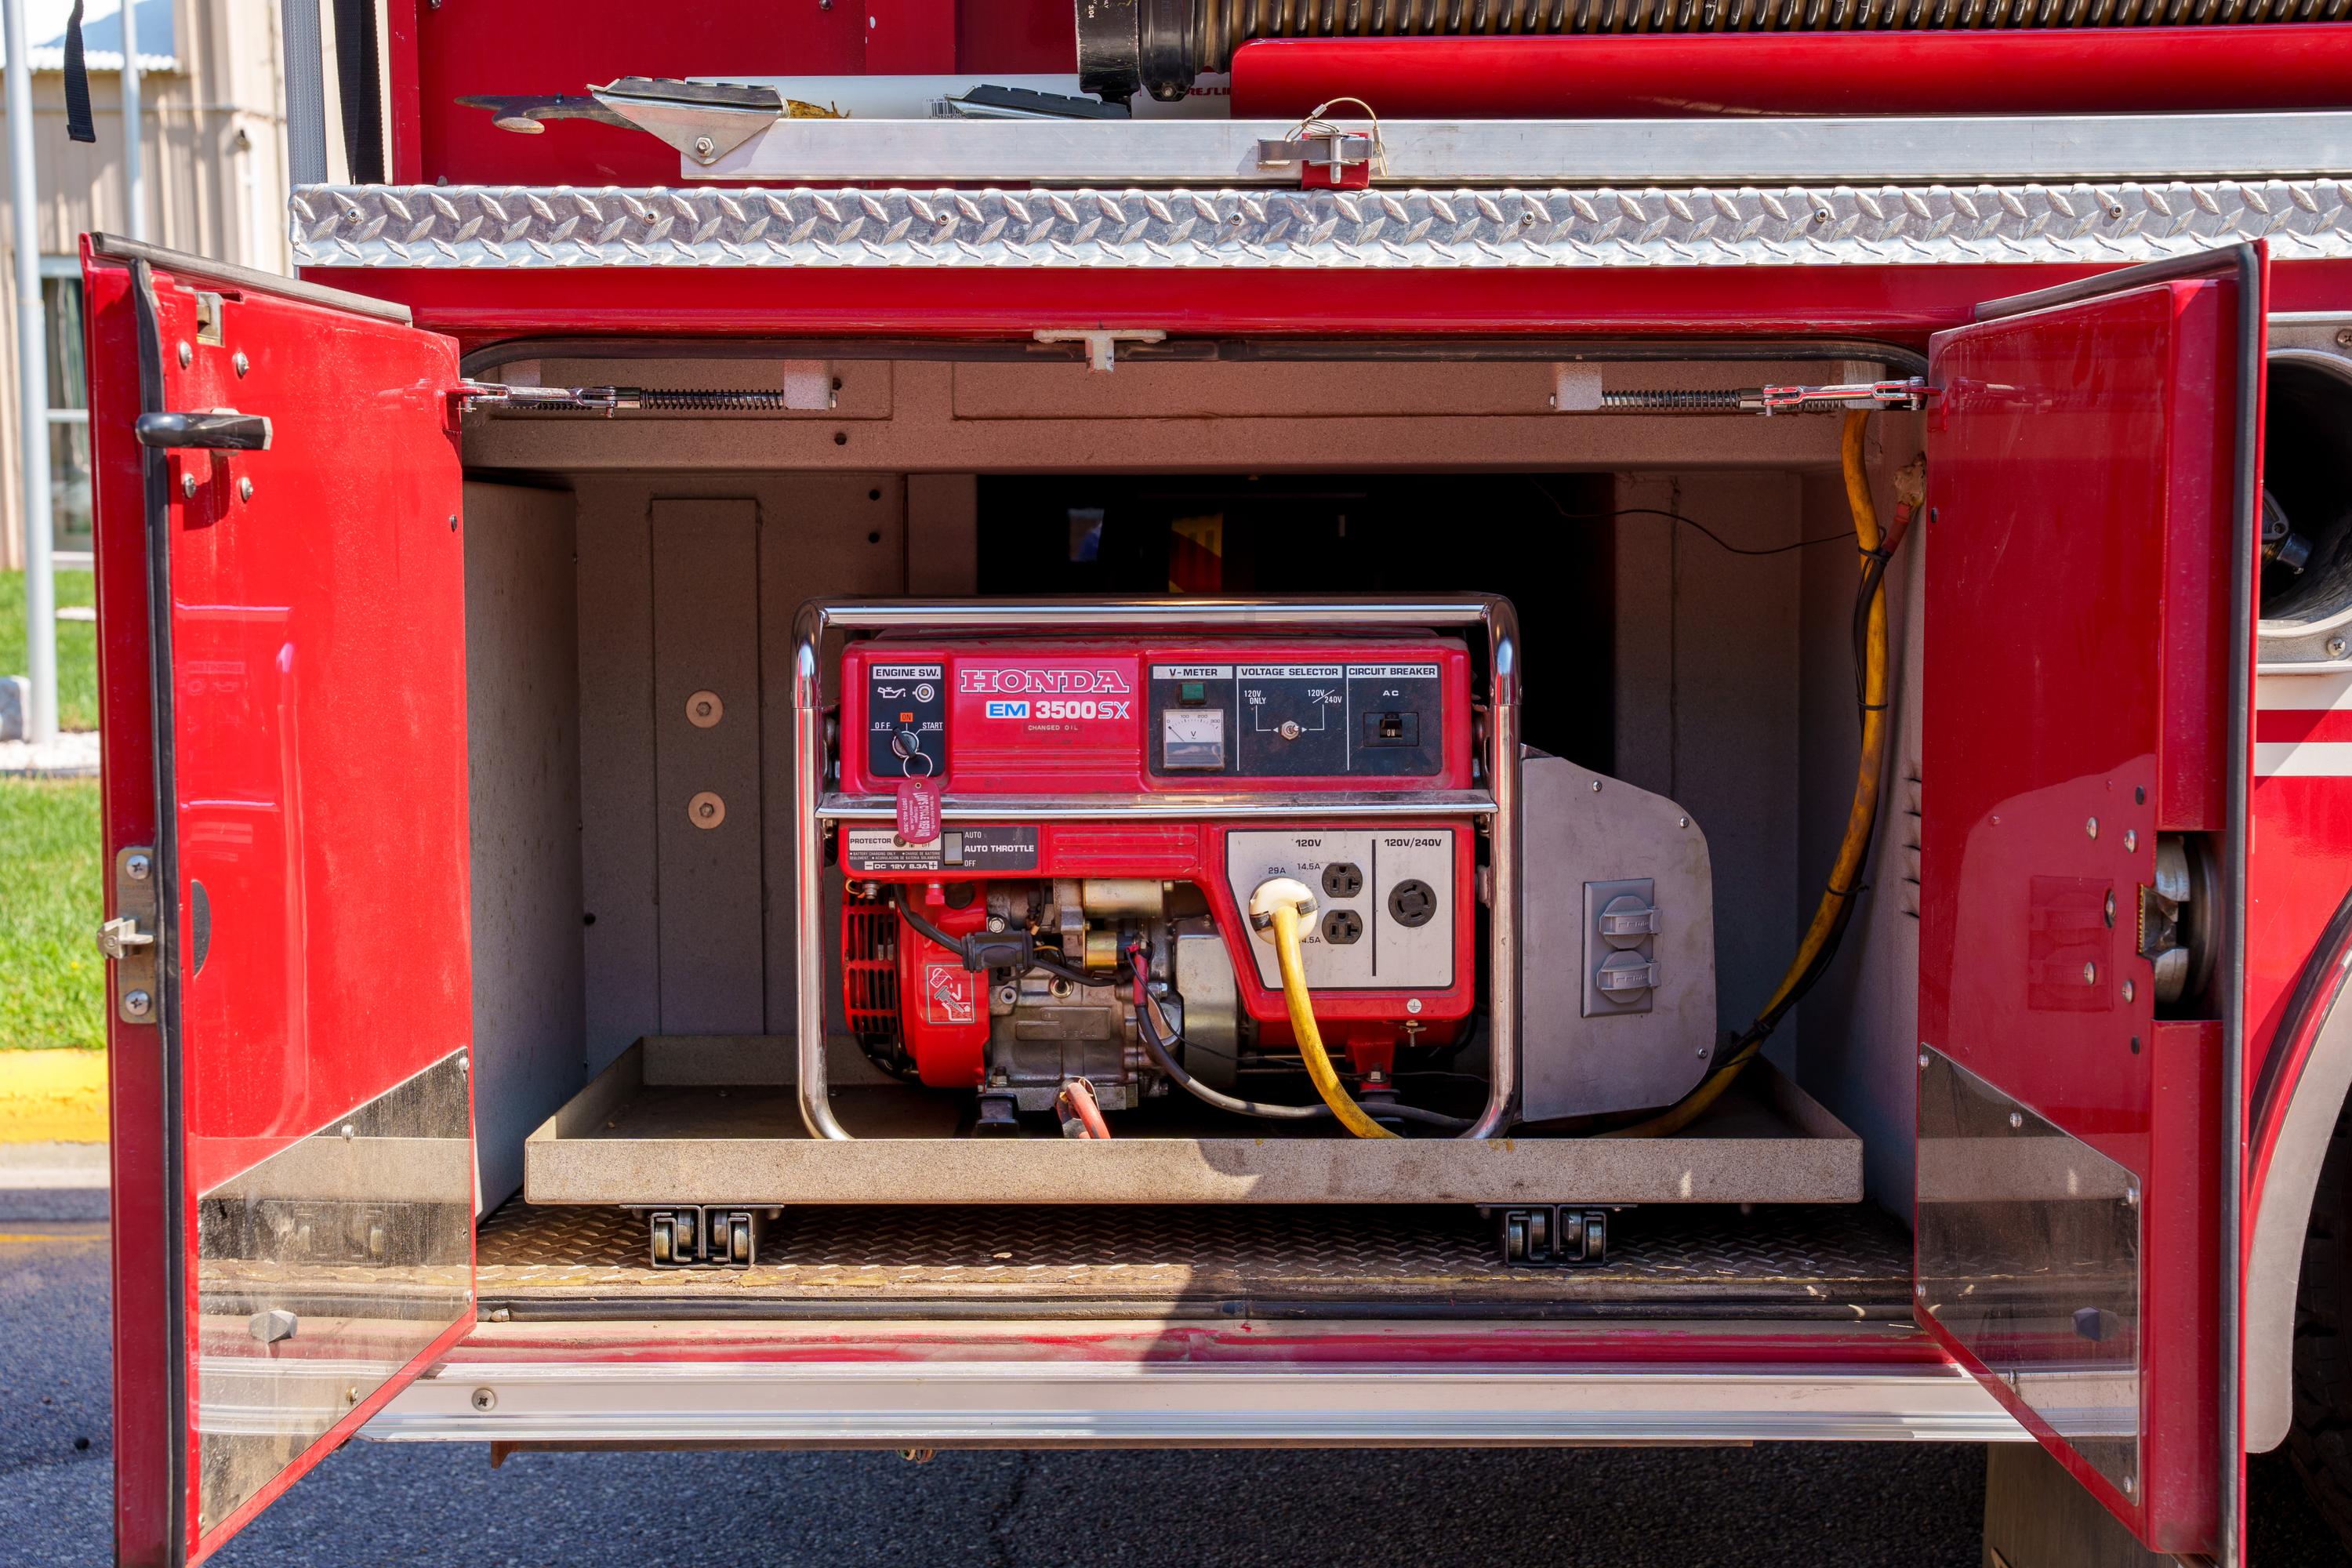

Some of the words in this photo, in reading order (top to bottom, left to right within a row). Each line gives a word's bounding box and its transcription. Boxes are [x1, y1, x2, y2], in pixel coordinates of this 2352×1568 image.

[919, 668, 938, 677] SW.
[1170, 668, 1218, 677] V-METER
[960, 669, 1131, 693] HONDA
[989, 704, 1026, 716] EM
[1036, 701, 1130, 719] 3500SX
[1386, 728, 1396, 737] ON
[1385, 839, 1442, 848] 120V/240V
